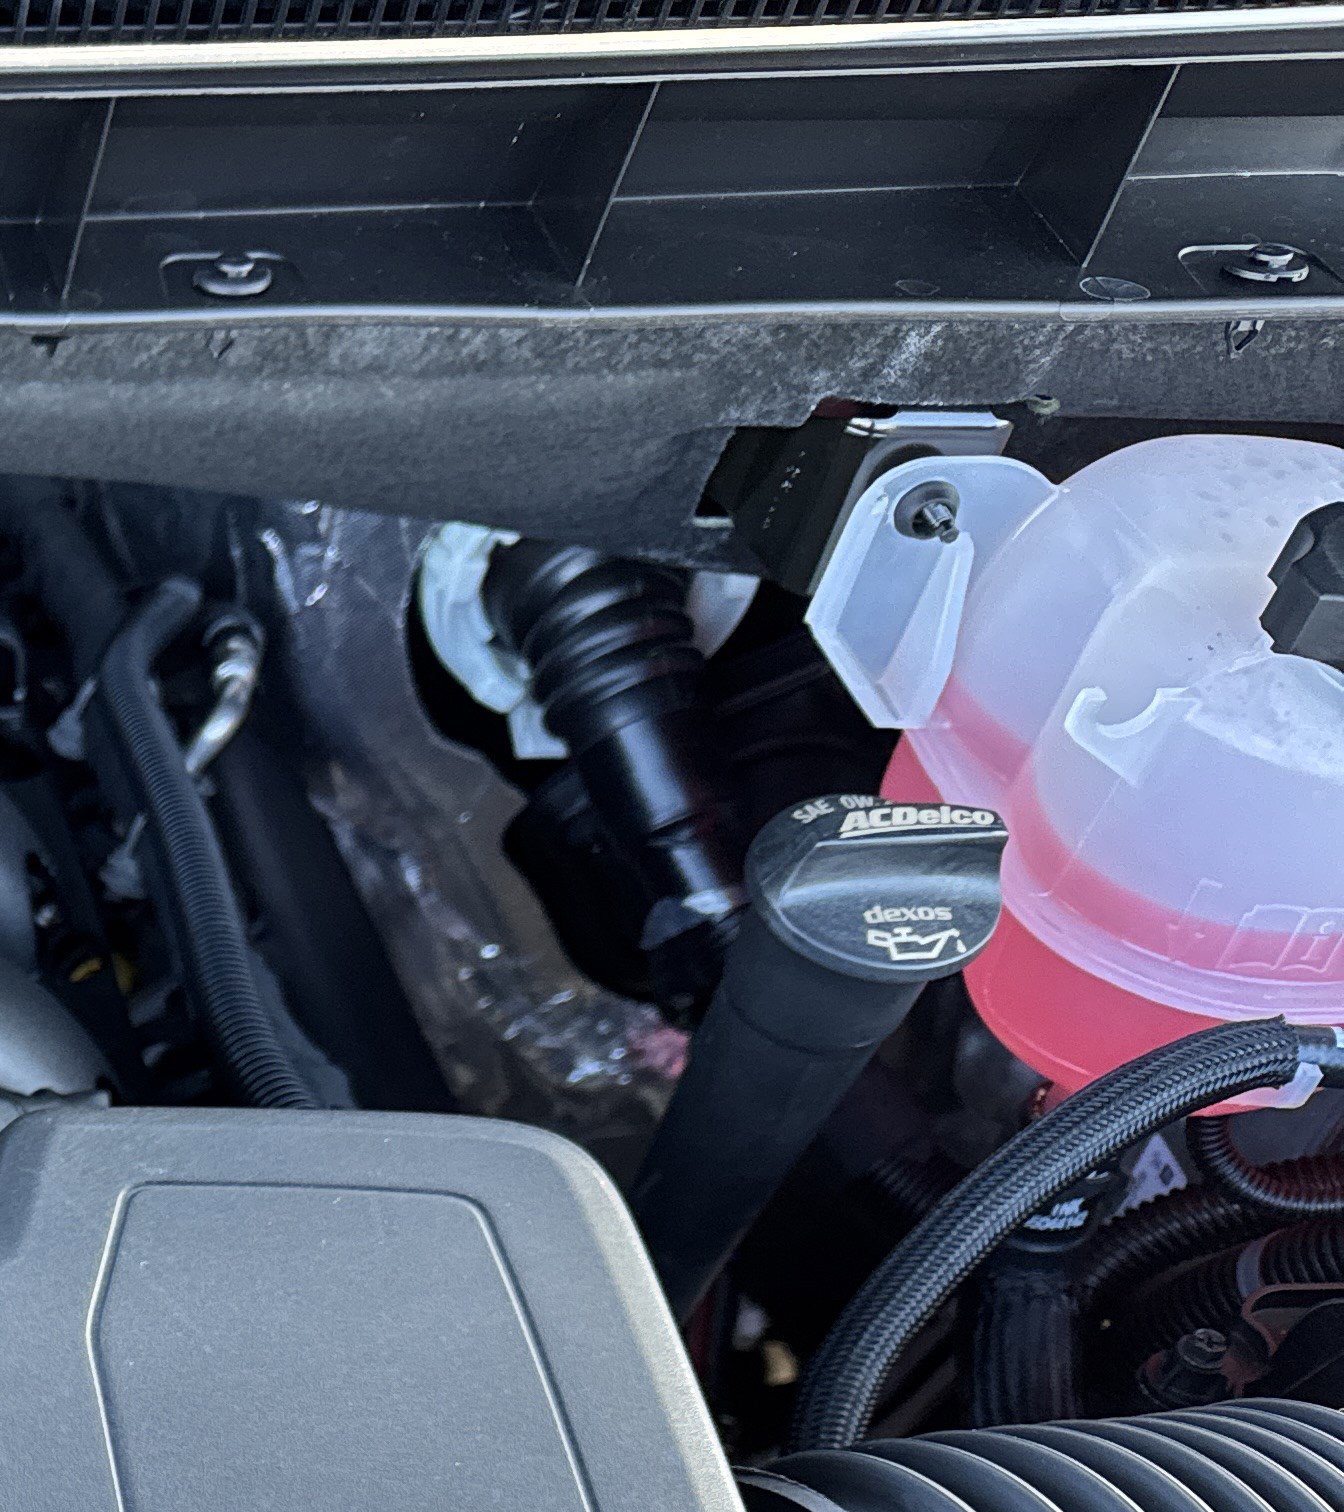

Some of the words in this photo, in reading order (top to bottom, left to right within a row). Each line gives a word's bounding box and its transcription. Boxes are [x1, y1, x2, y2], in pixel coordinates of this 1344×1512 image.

[792, 799, 835, 824] SAE
[839, 806, 995, 833] ACDelco
[863, 905, 953, 924] dexos
